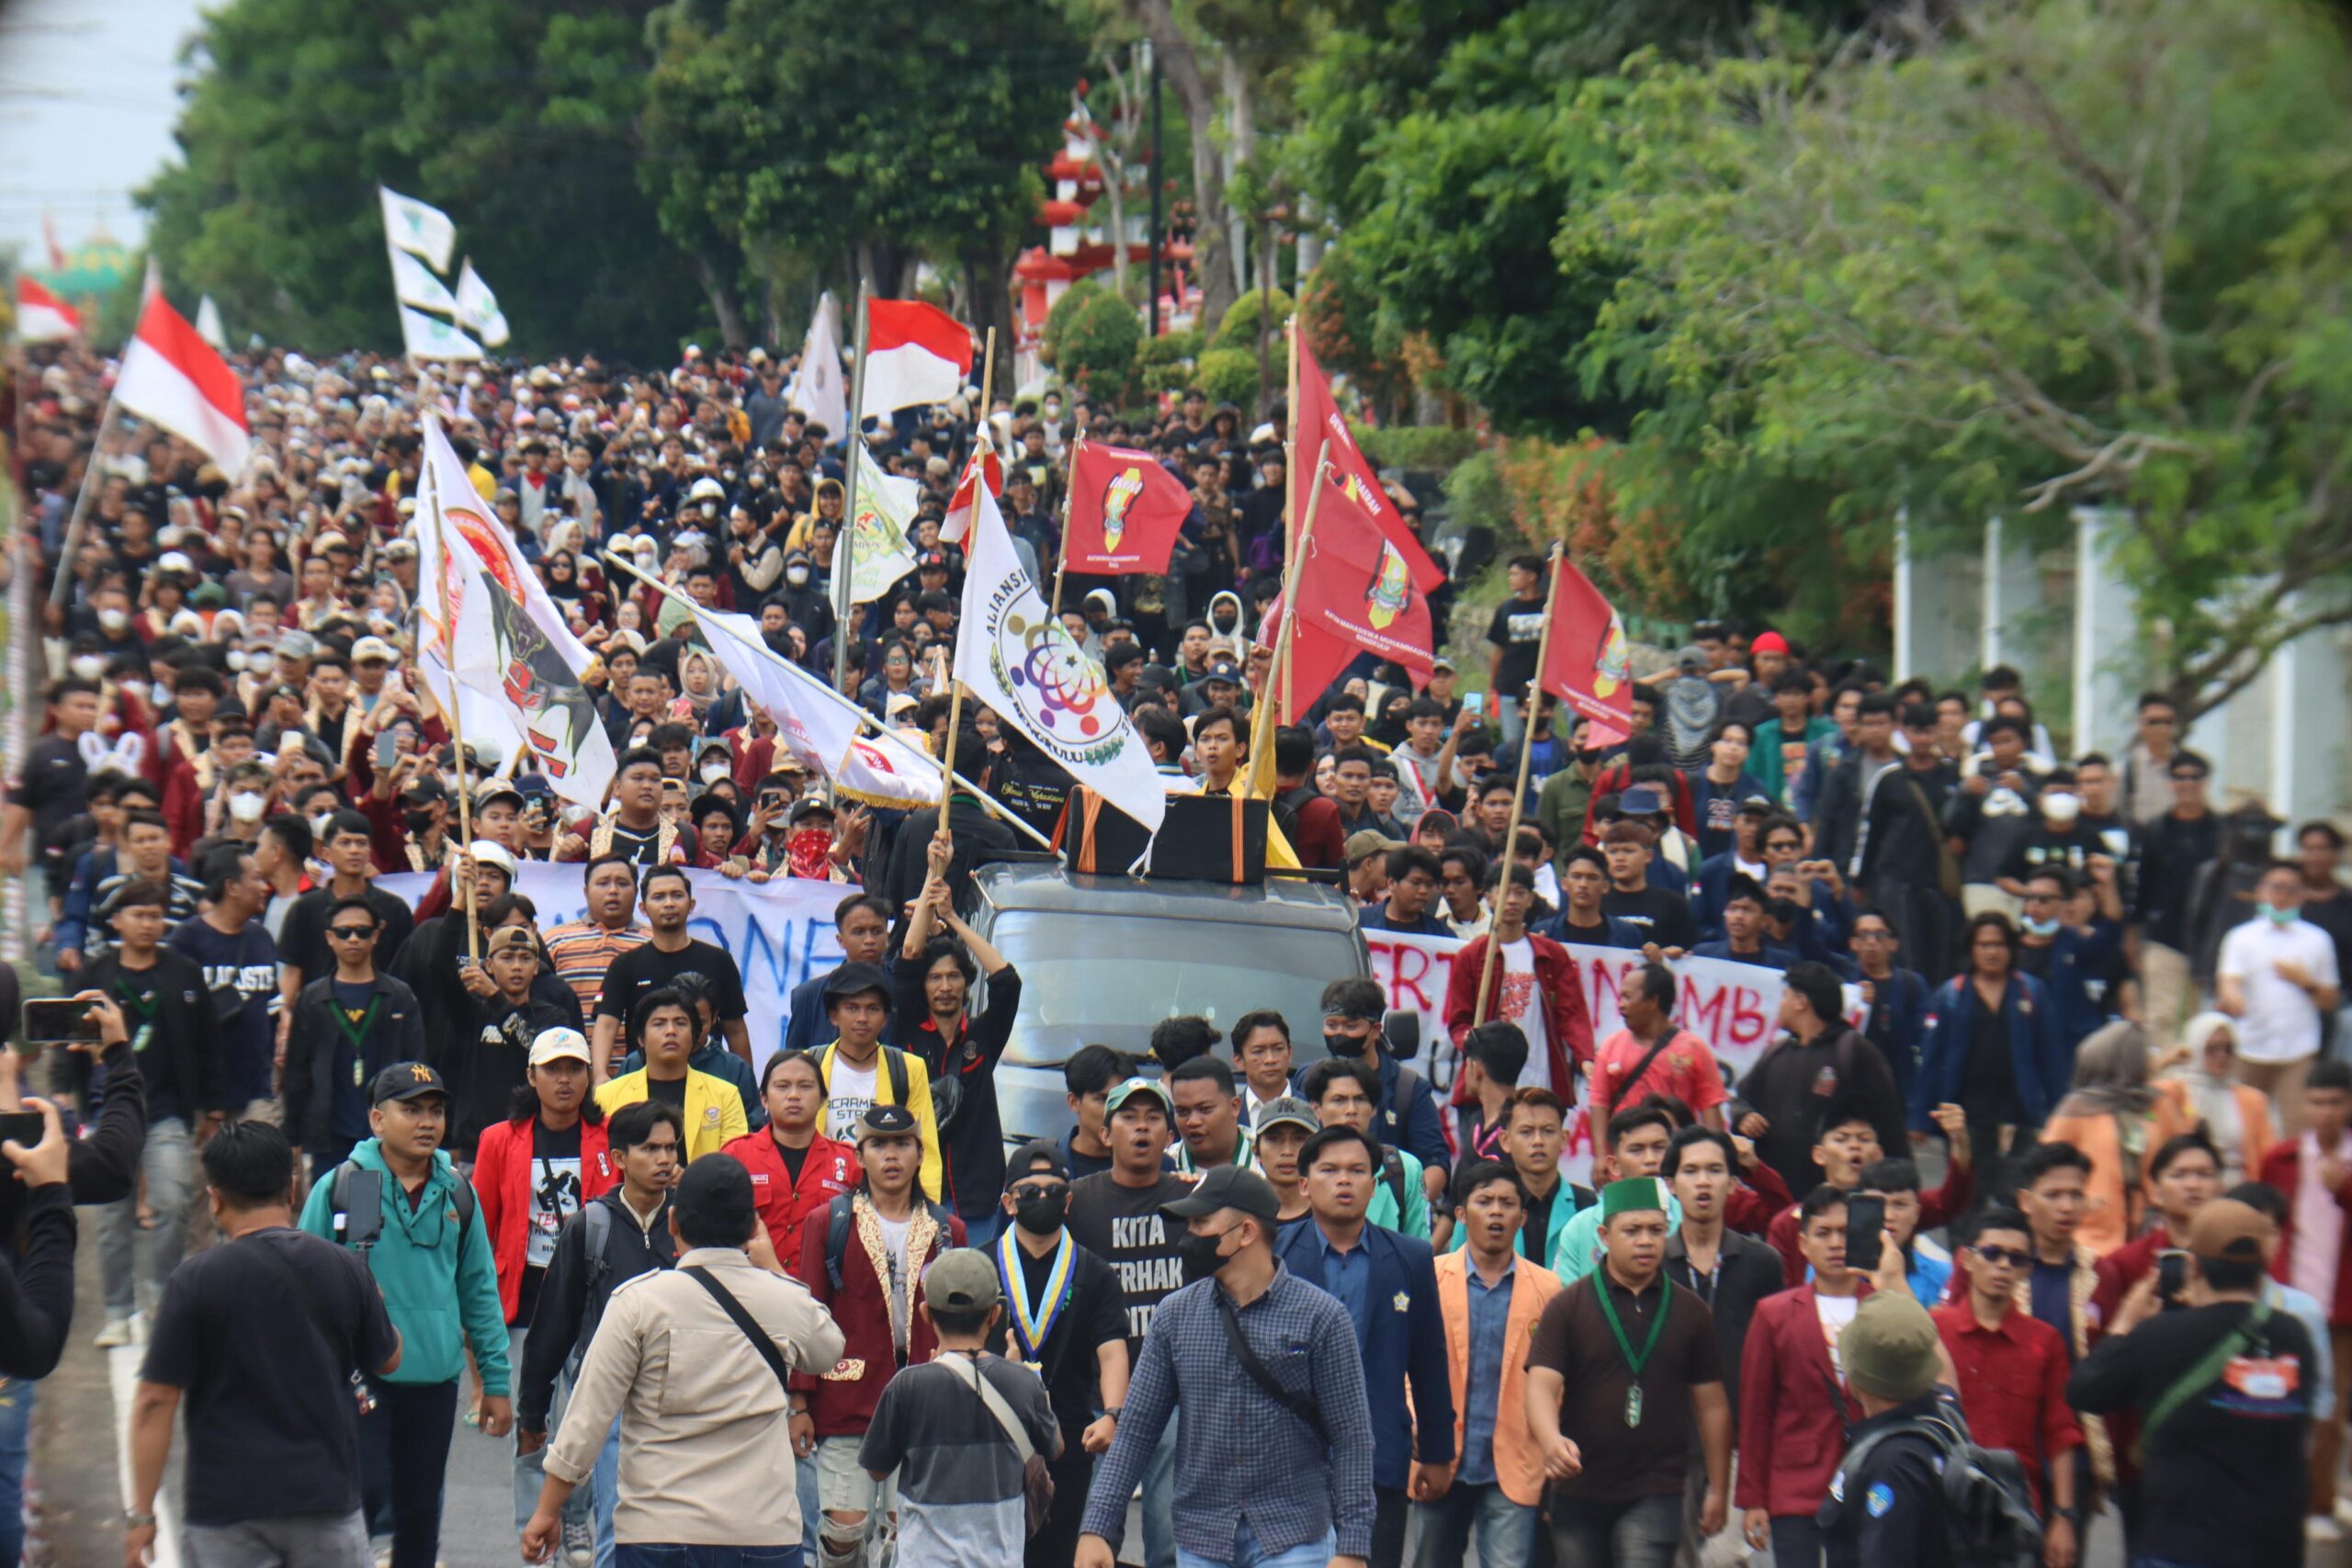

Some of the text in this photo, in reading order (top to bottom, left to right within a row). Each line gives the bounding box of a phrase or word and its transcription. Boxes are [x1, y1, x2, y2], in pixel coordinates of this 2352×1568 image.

[986, 568, 1028, 637] ALIANSI
[1339, 619, 1379, 642] MAHASISWA
[1355, 633, 1391, 653] BENGKULU
[1012, 701, 1085, 763] BENGKULU
[1112, 1213, 1166, 1249] KITA
[1109, 1256, 1183, 1293] RHAK
